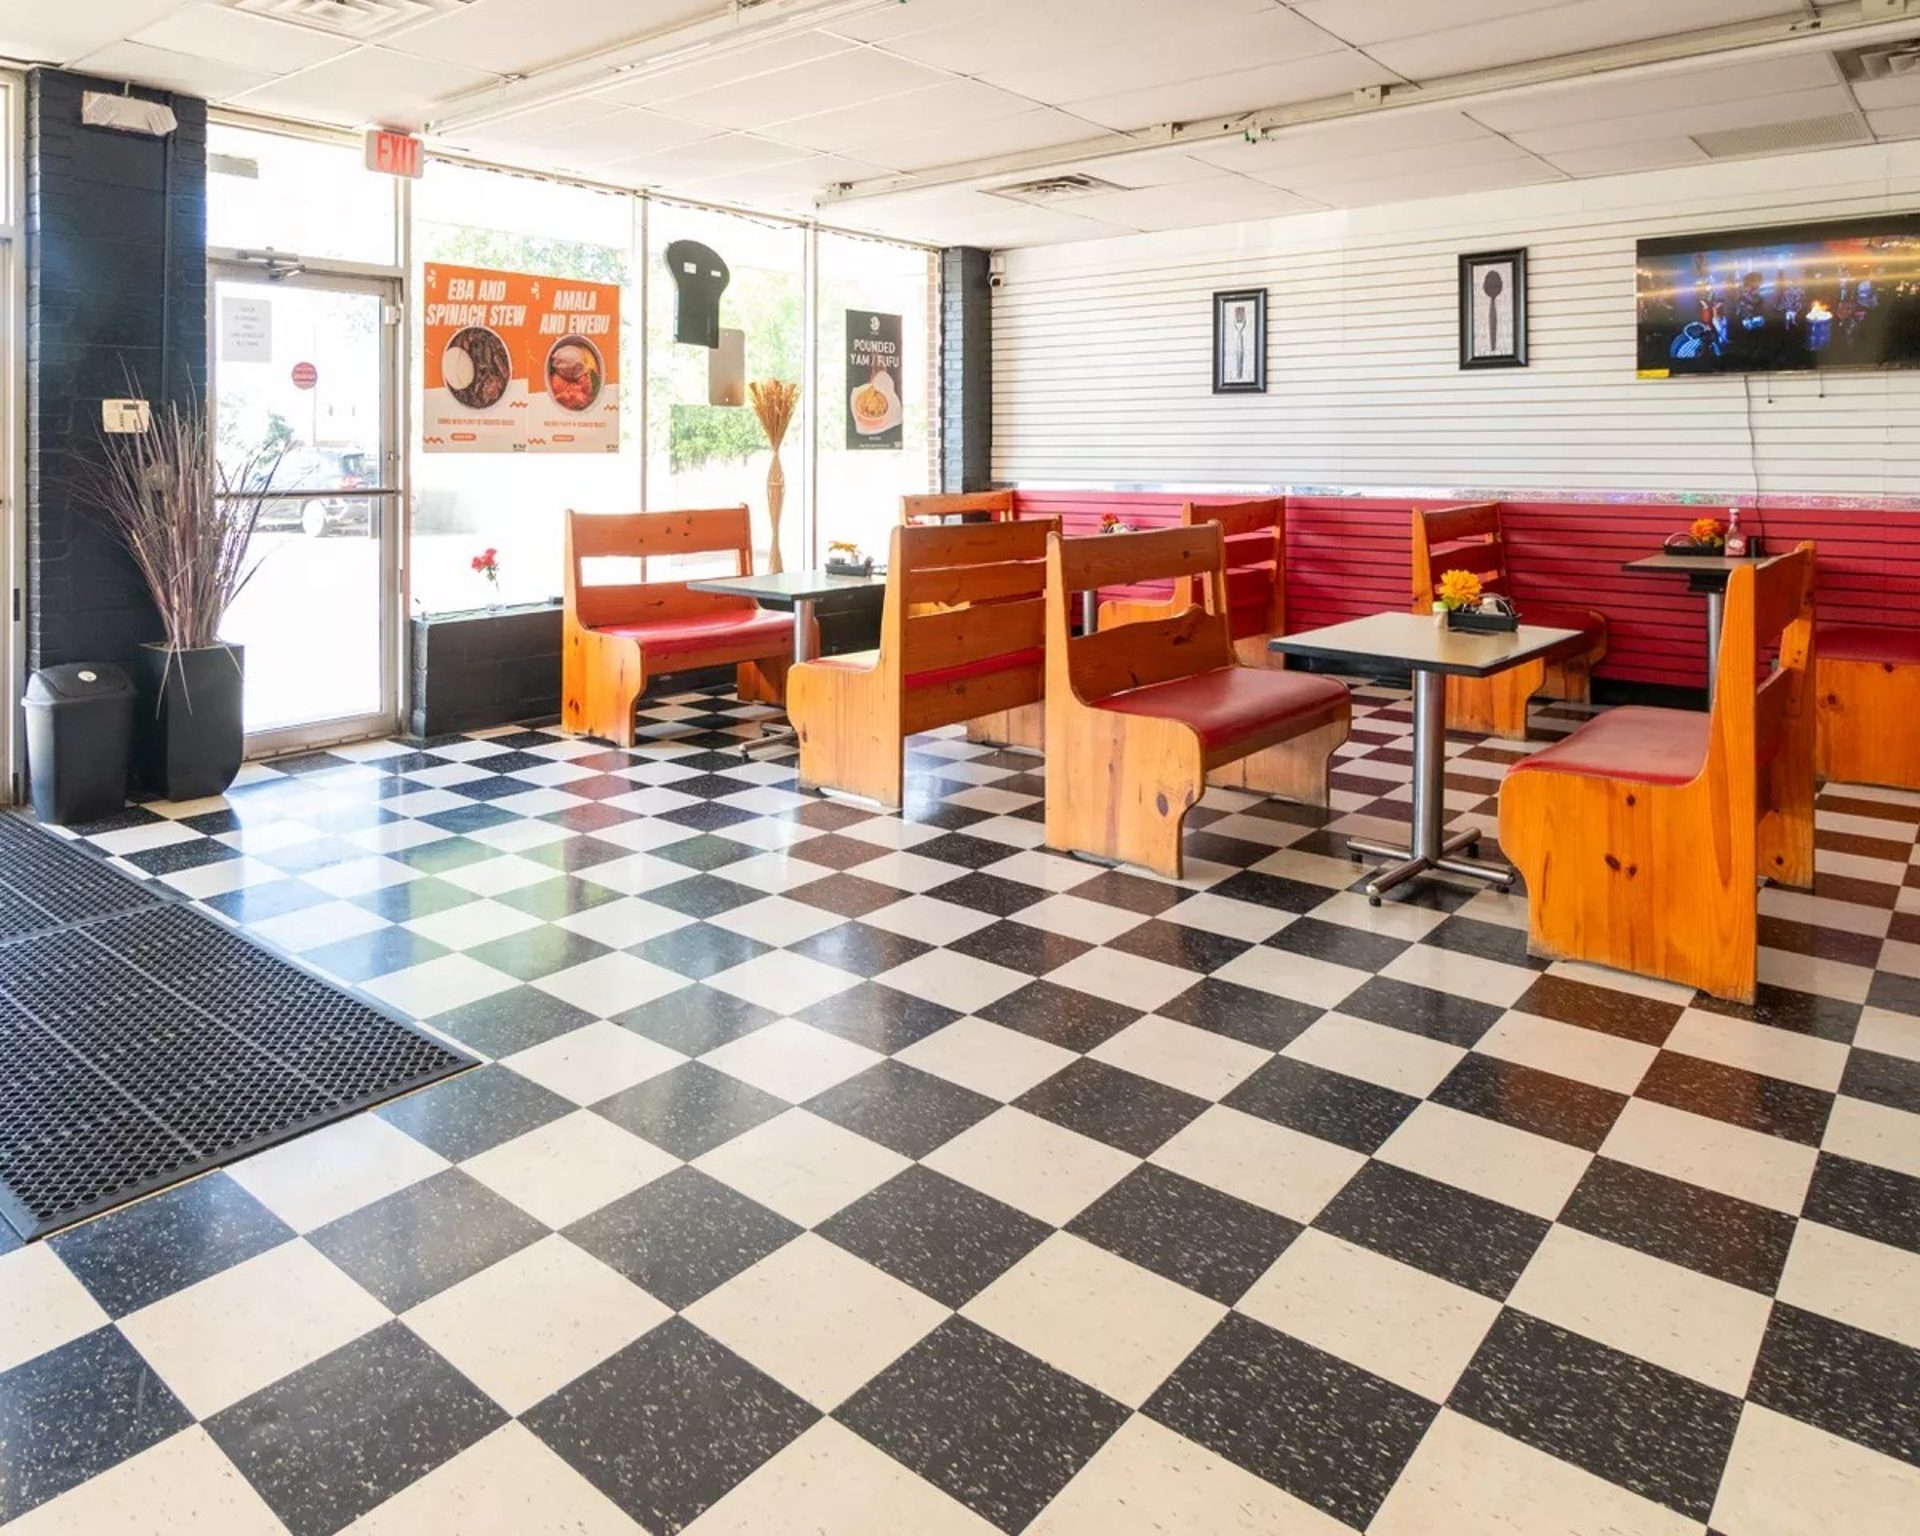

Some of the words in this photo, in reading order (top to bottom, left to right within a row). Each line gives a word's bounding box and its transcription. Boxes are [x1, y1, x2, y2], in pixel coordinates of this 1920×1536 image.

[376, 131, 418, 174] EXIT
[448, 278, 475, 301] EBA
[478, 280, 507, 302] AND
[553, 290, 597, 311] AMALA
[426, 303, 487, 327] SPINACH
[489, 305, 527, 327] STEW
[539, 313, 566, 334] AND
[567, 314, 610, 334] EWEDU
[853, 339, 896, 354] POUNDED
[850, 353, 870, 366] YAM
[877, 355, 900, 368] FUFU
